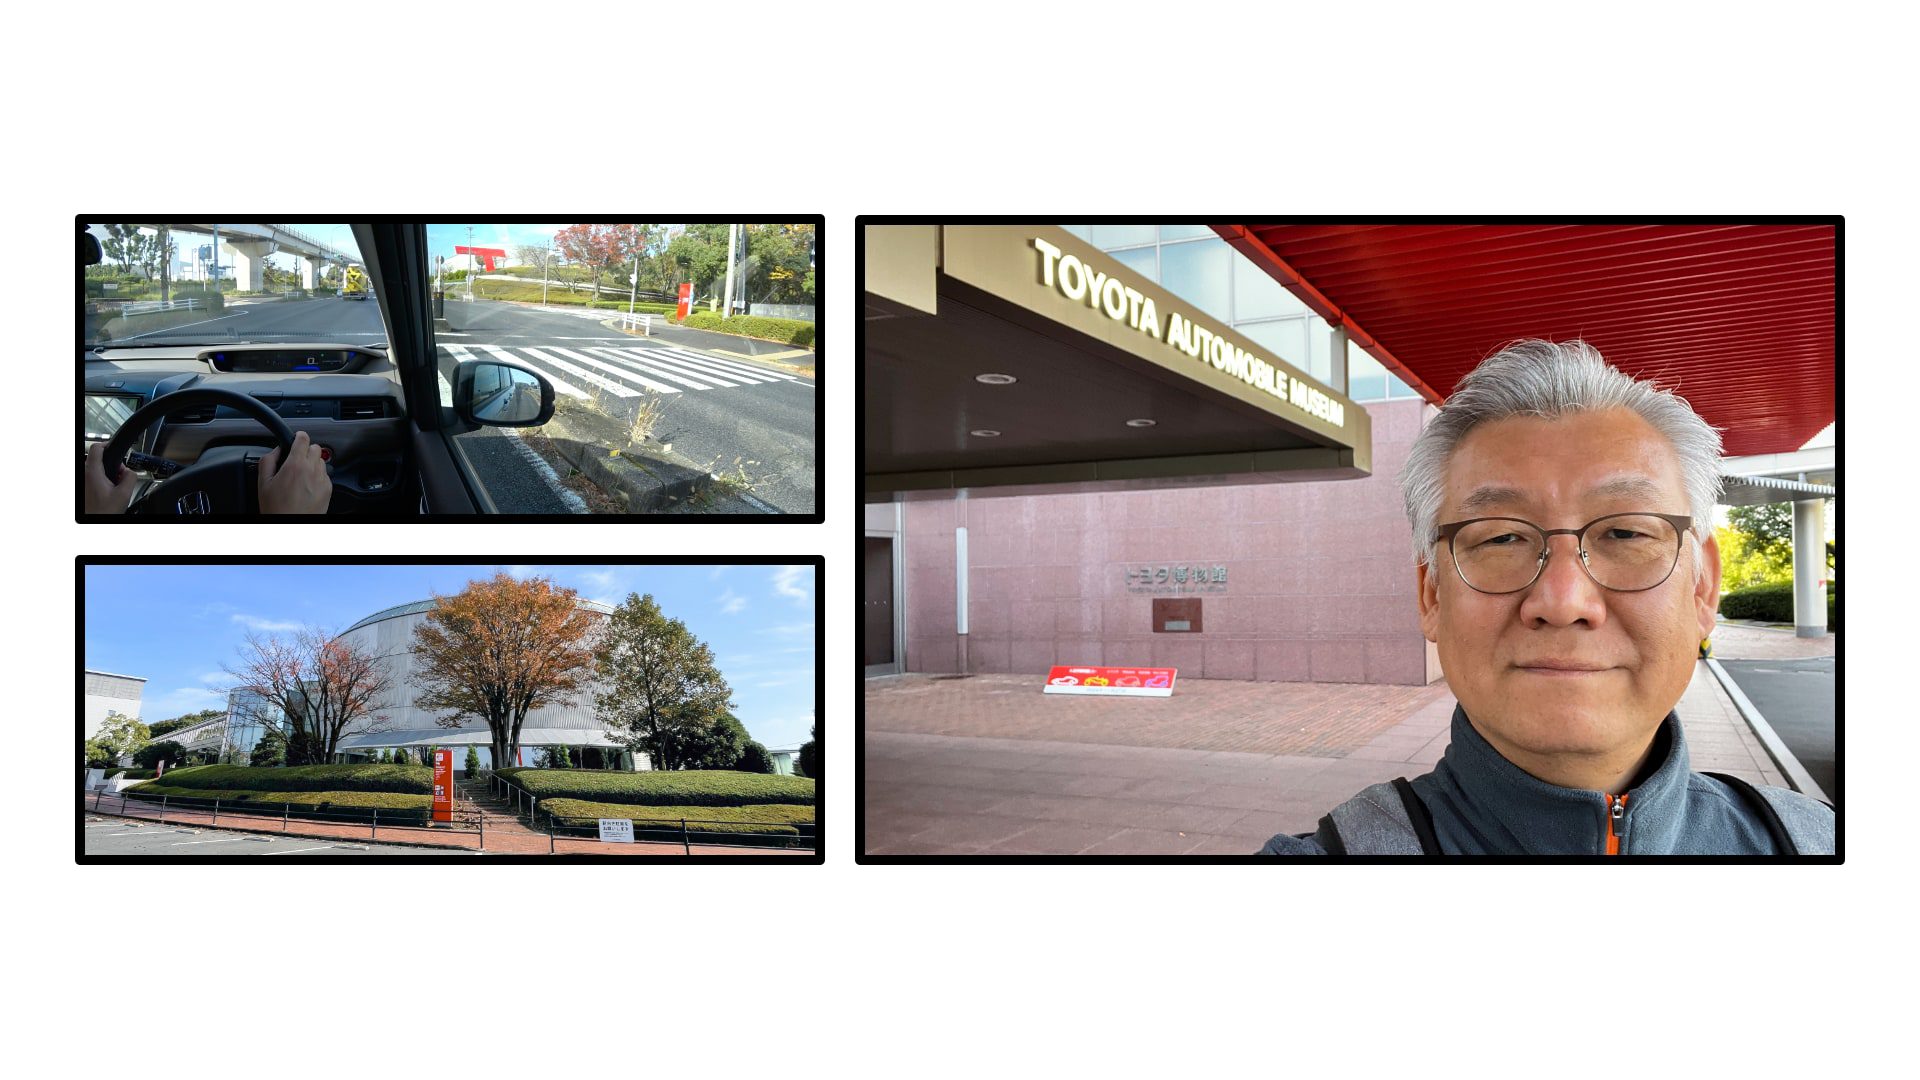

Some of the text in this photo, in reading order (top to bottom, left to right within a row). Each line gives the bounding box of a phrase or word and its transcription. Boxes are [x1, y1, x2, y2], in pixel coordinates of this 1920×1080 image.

[1034, 237, 1344, 428] TOYOTA AUTOMOBILE MUSEUM
[1126, 566, 1228, 585] トヨタ博物館
